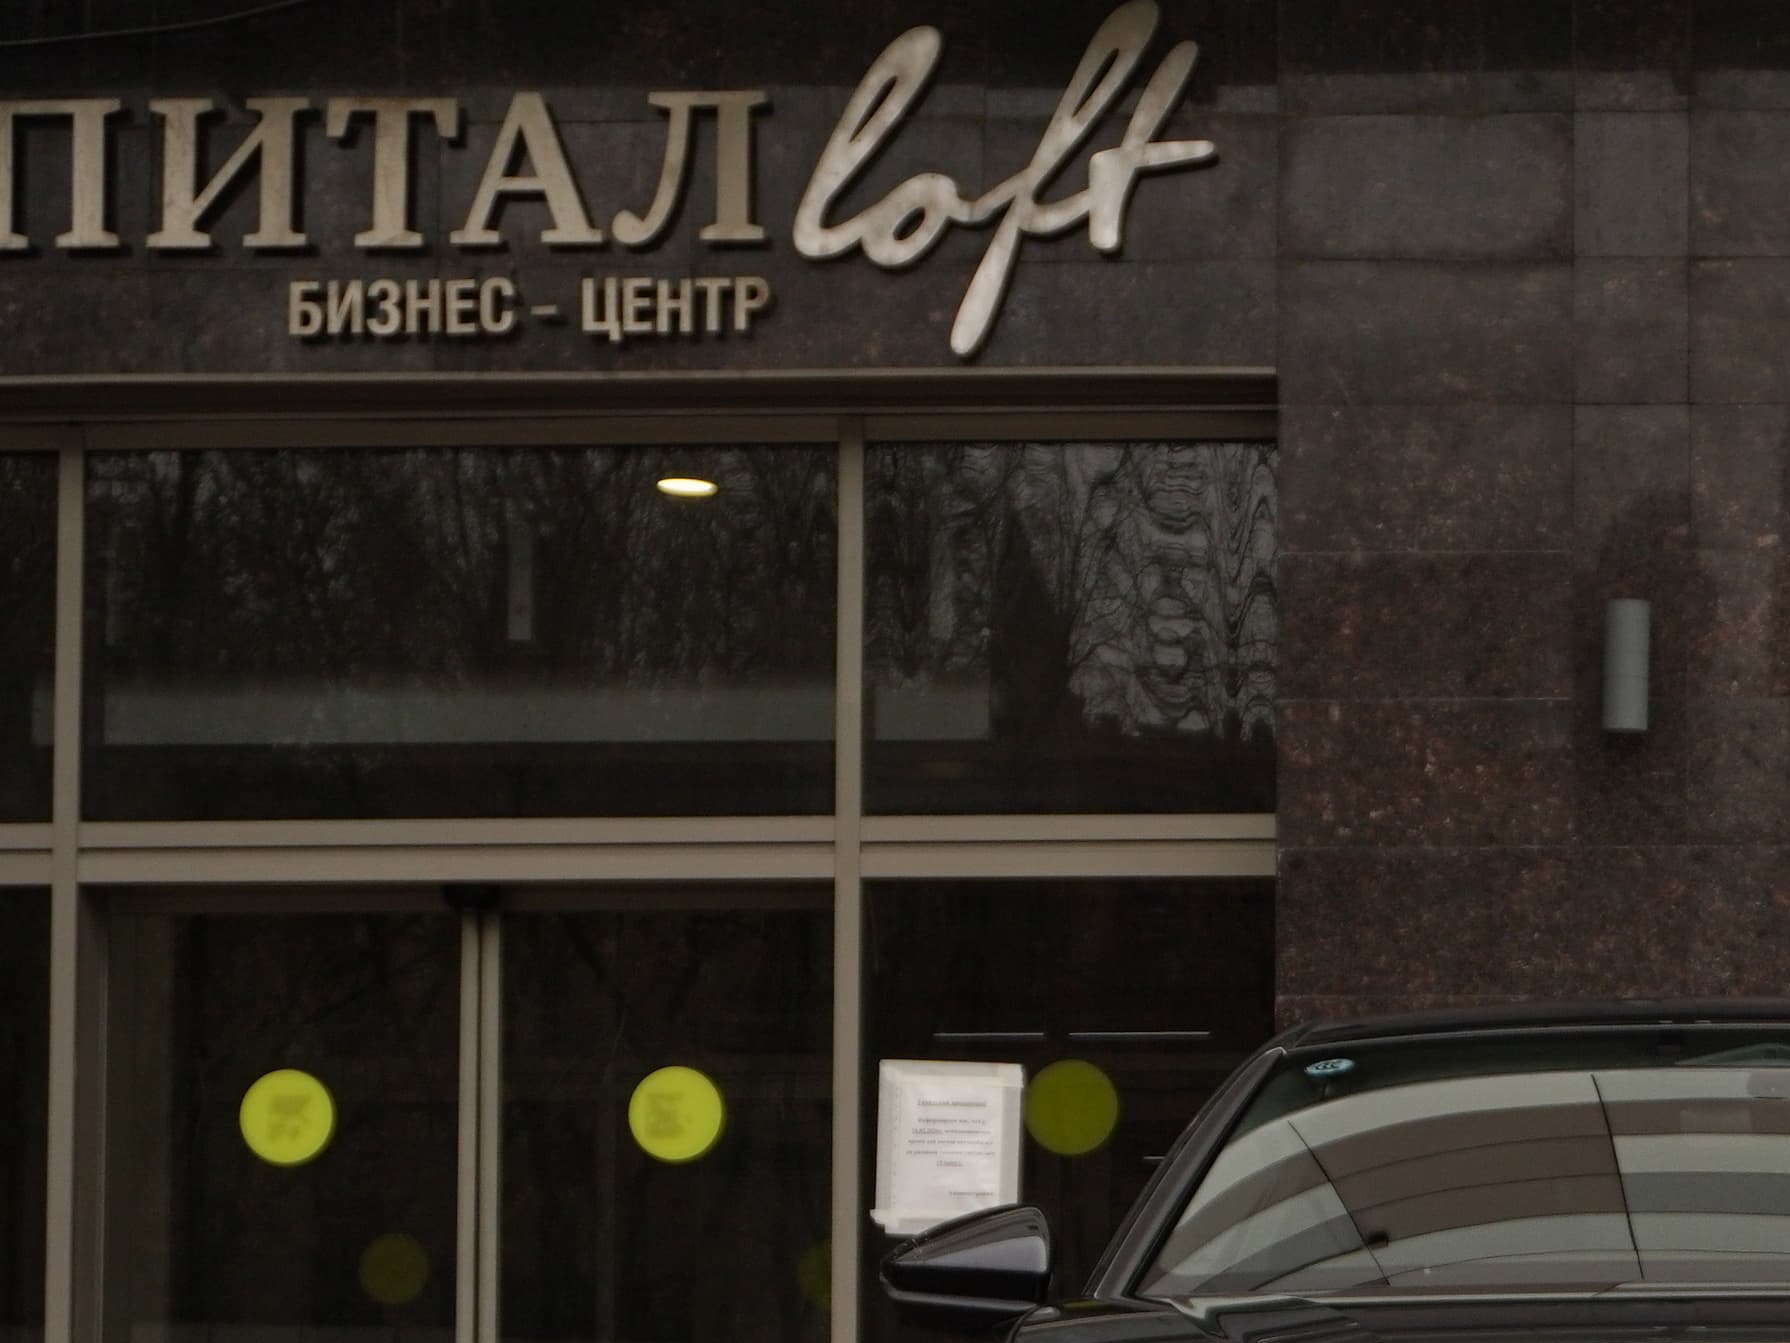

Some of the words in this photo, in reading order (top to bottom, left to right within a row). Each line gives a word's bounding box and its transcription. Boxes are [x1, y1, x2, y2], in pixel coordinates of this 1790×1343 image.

[0, 91, 767, 249] ПИТАЛ
[794, 1, 1215, 358] loft
[288, 278, 515, 336] БИЗНЕС
[582, 277, 770, 342] ЦЕНТР
